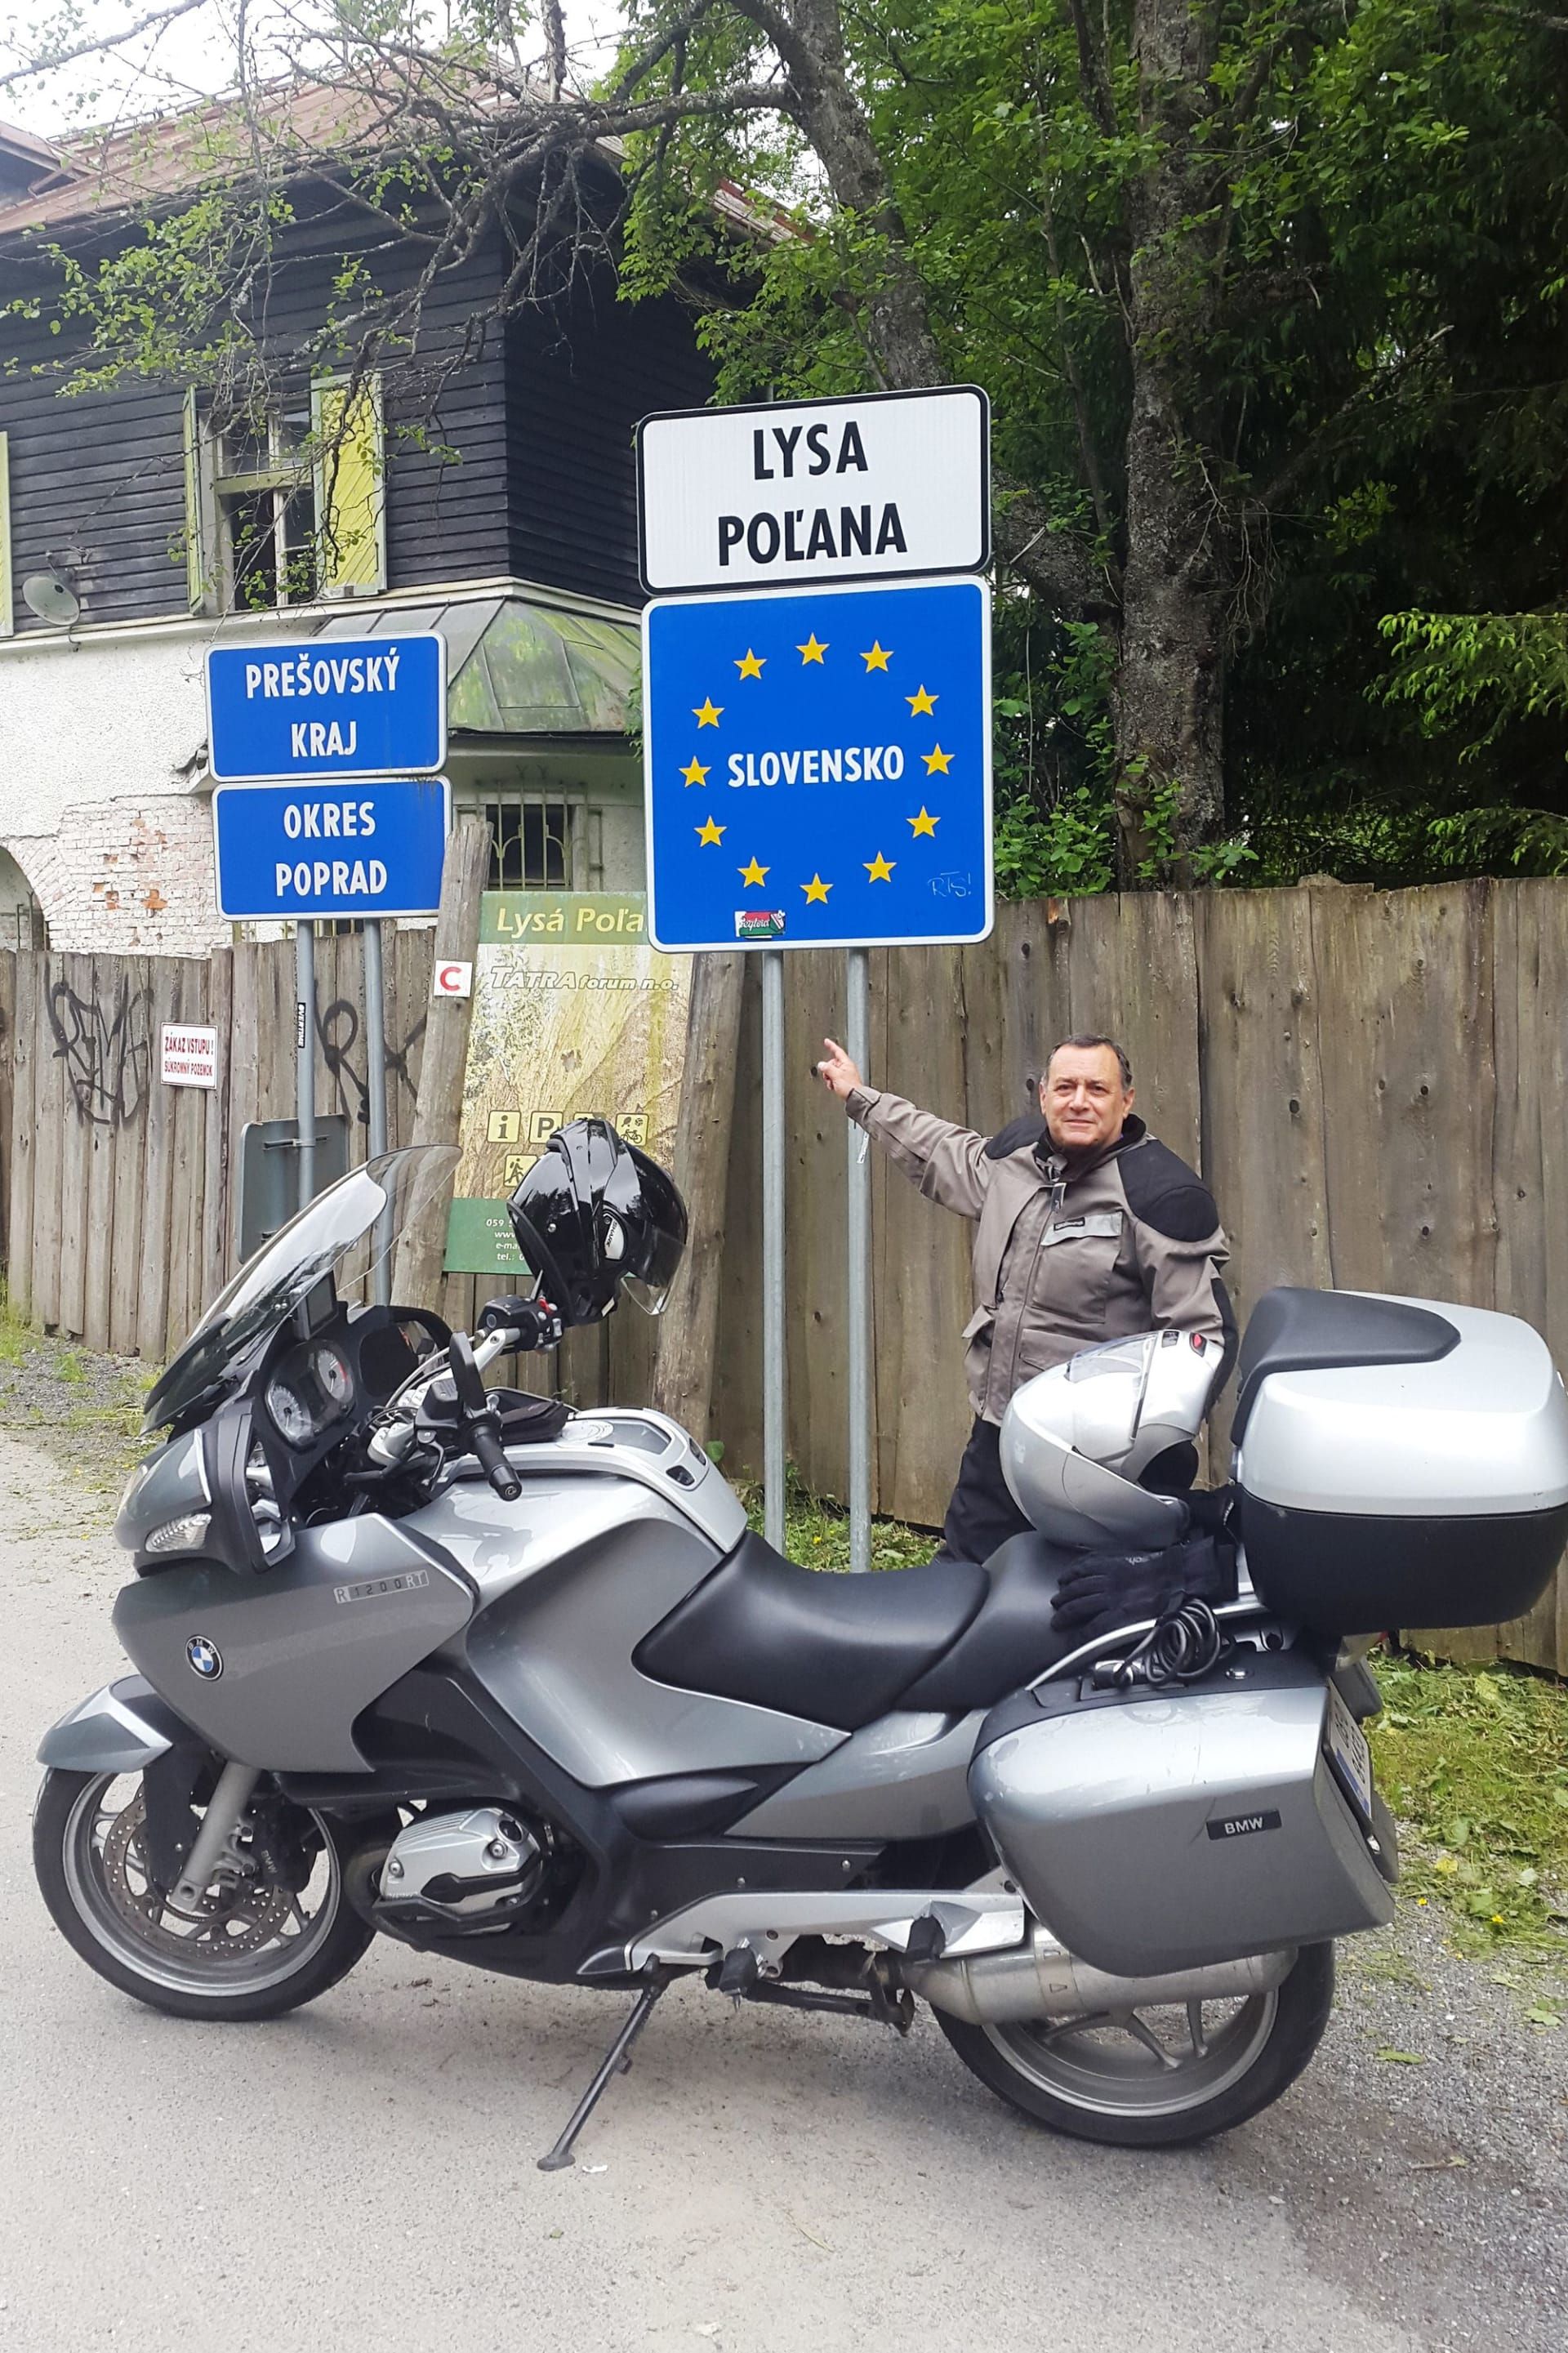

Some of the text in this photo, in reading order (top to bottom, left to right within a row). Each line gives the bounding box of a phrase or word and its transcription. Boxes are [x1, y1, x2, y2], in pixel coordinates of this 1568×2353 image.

[753, 421, 869, 480] LYSA
[718, 502, 908, 567] POĽANA
[246, 647, 400, 699] PREŠOVSKÝ
[291, 721, 358, 758] KRAJ
[728, 745, 904, 788] SLOVENSKO
[283, 801, 376, 839] OKRES
[275, 859, 387, 897] POPRAD
[497, 907, 648, 939] Lysá Poľa
[439, 966, 462, 992] C
[491, 966, 679, 991] TATRA forum n.o.
[486, 1219, 505, 1228] 059
[1224, 1816, 1263, 1835] BMW
